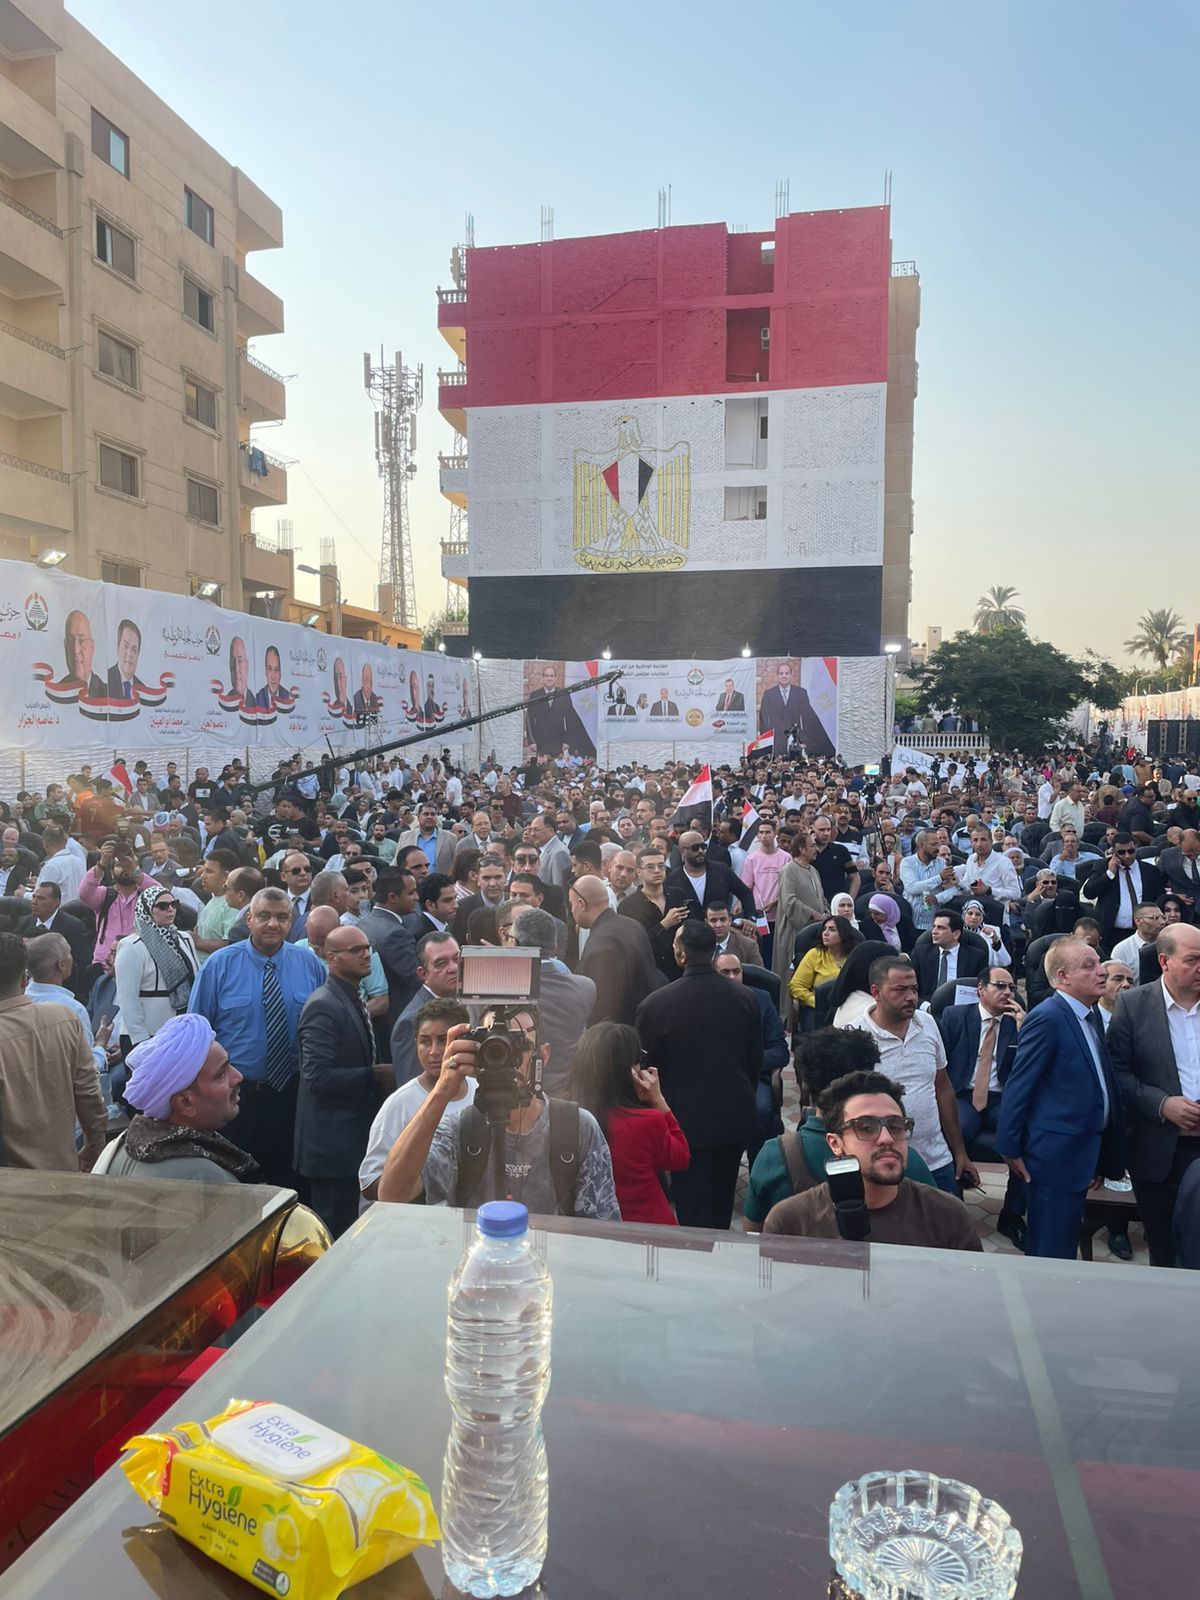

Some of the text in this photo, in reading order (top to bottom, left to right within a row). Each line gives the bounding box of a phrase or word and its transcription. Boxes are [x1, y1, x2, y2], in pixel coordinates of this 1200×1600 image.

[248, 1421, 312, 1459] Hygiene
[266, 1415, 300, 1437] Extra
[189, 1468, 225, 1498] Extra
[189, 1485, 257, 1536] Hygiene
